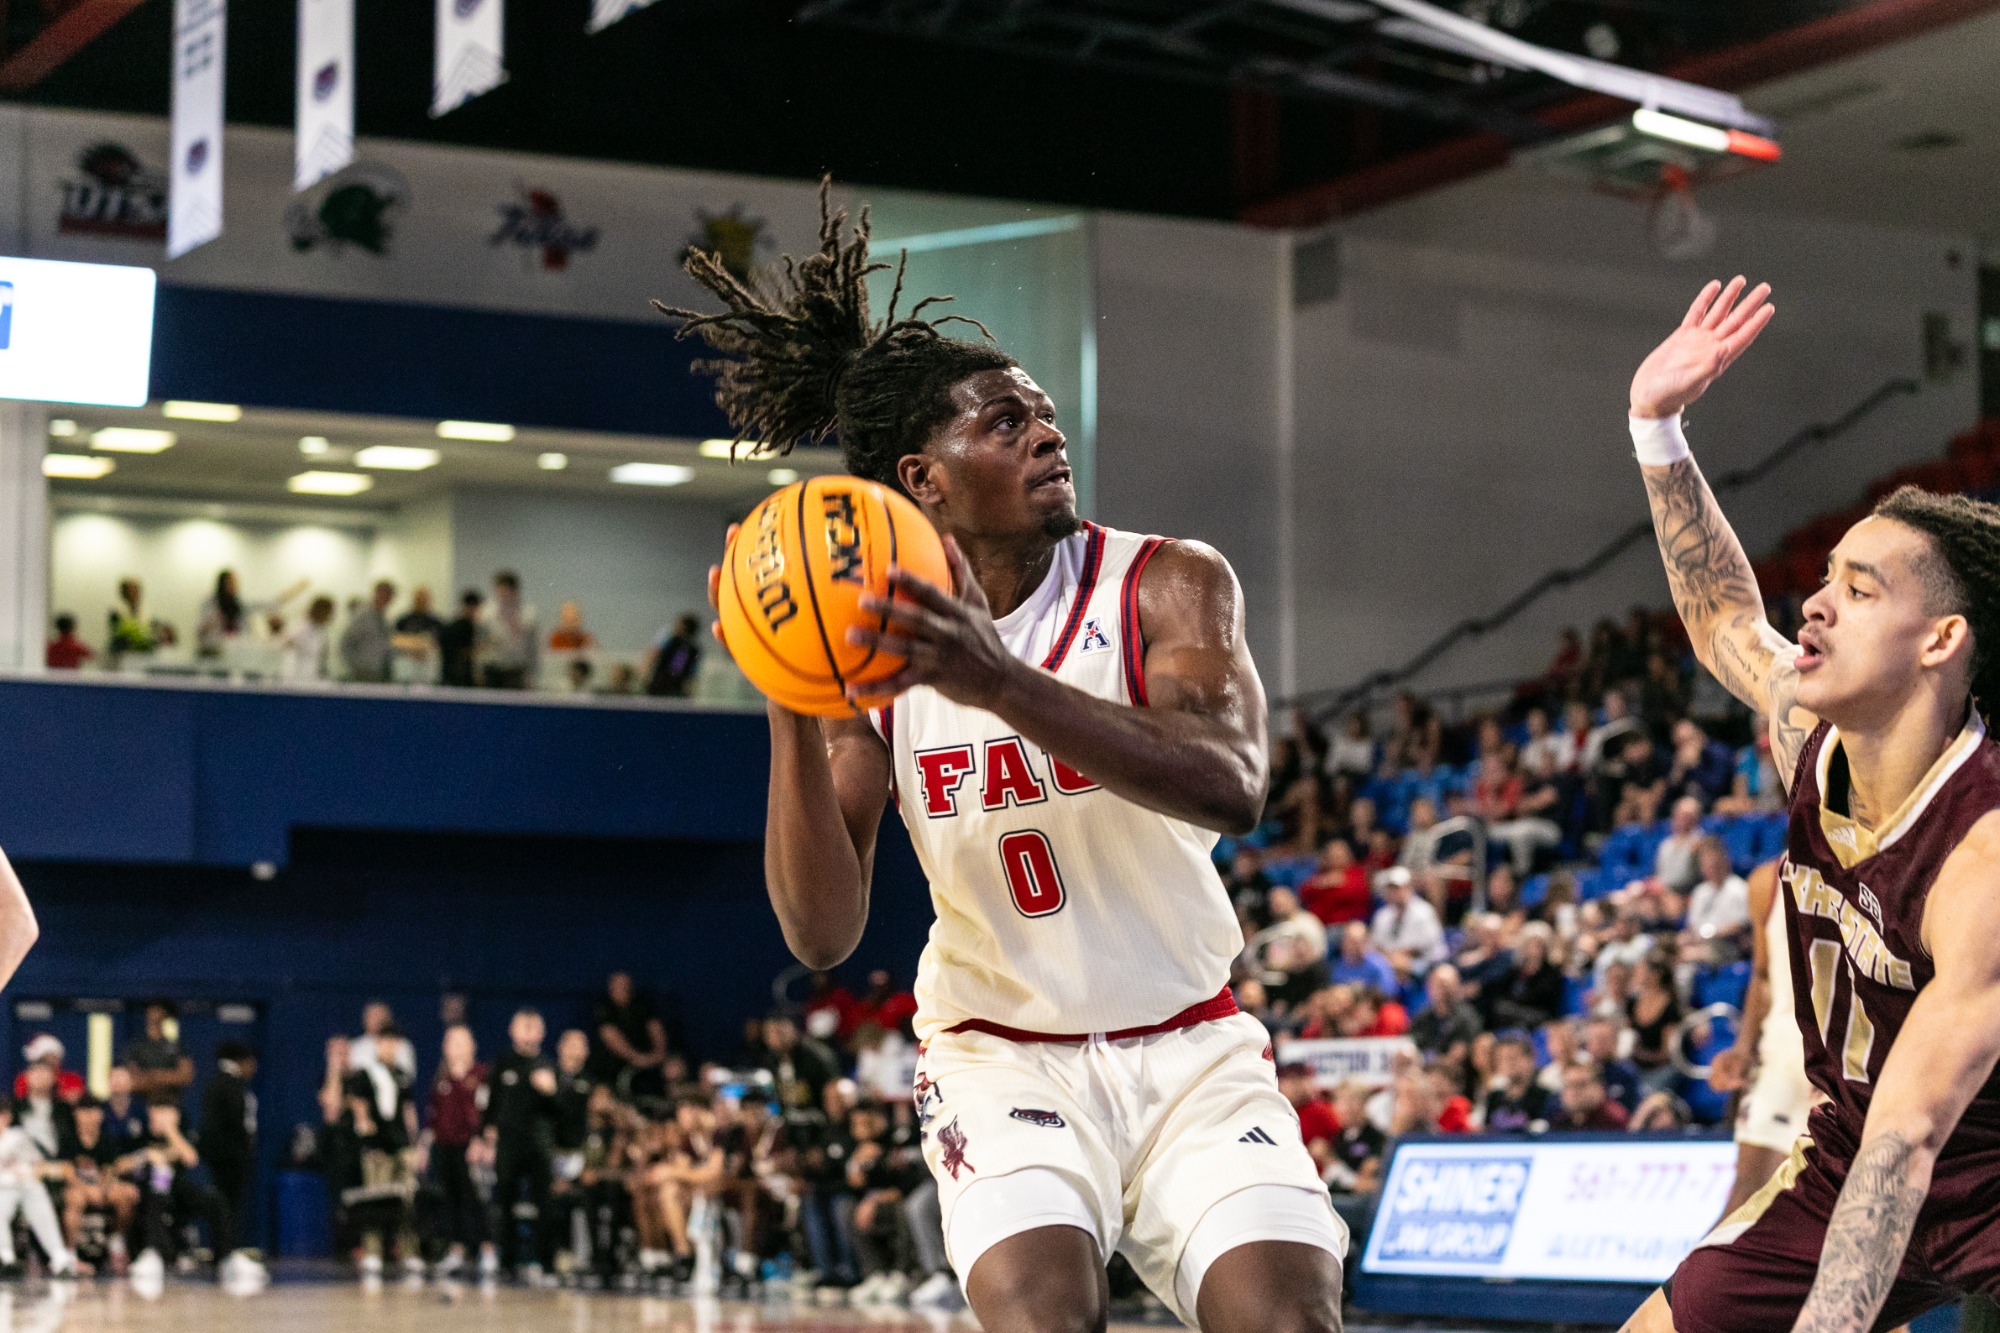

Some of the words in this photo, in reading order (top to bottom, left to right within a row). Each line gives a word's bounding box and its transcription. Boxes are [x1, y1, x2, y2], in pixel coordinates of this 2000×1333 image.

[998, 828, 1066, 918] 0
[1838, 897, 1917, 992] STATE
[1396, 1163, 1530, 1214] SHINER
